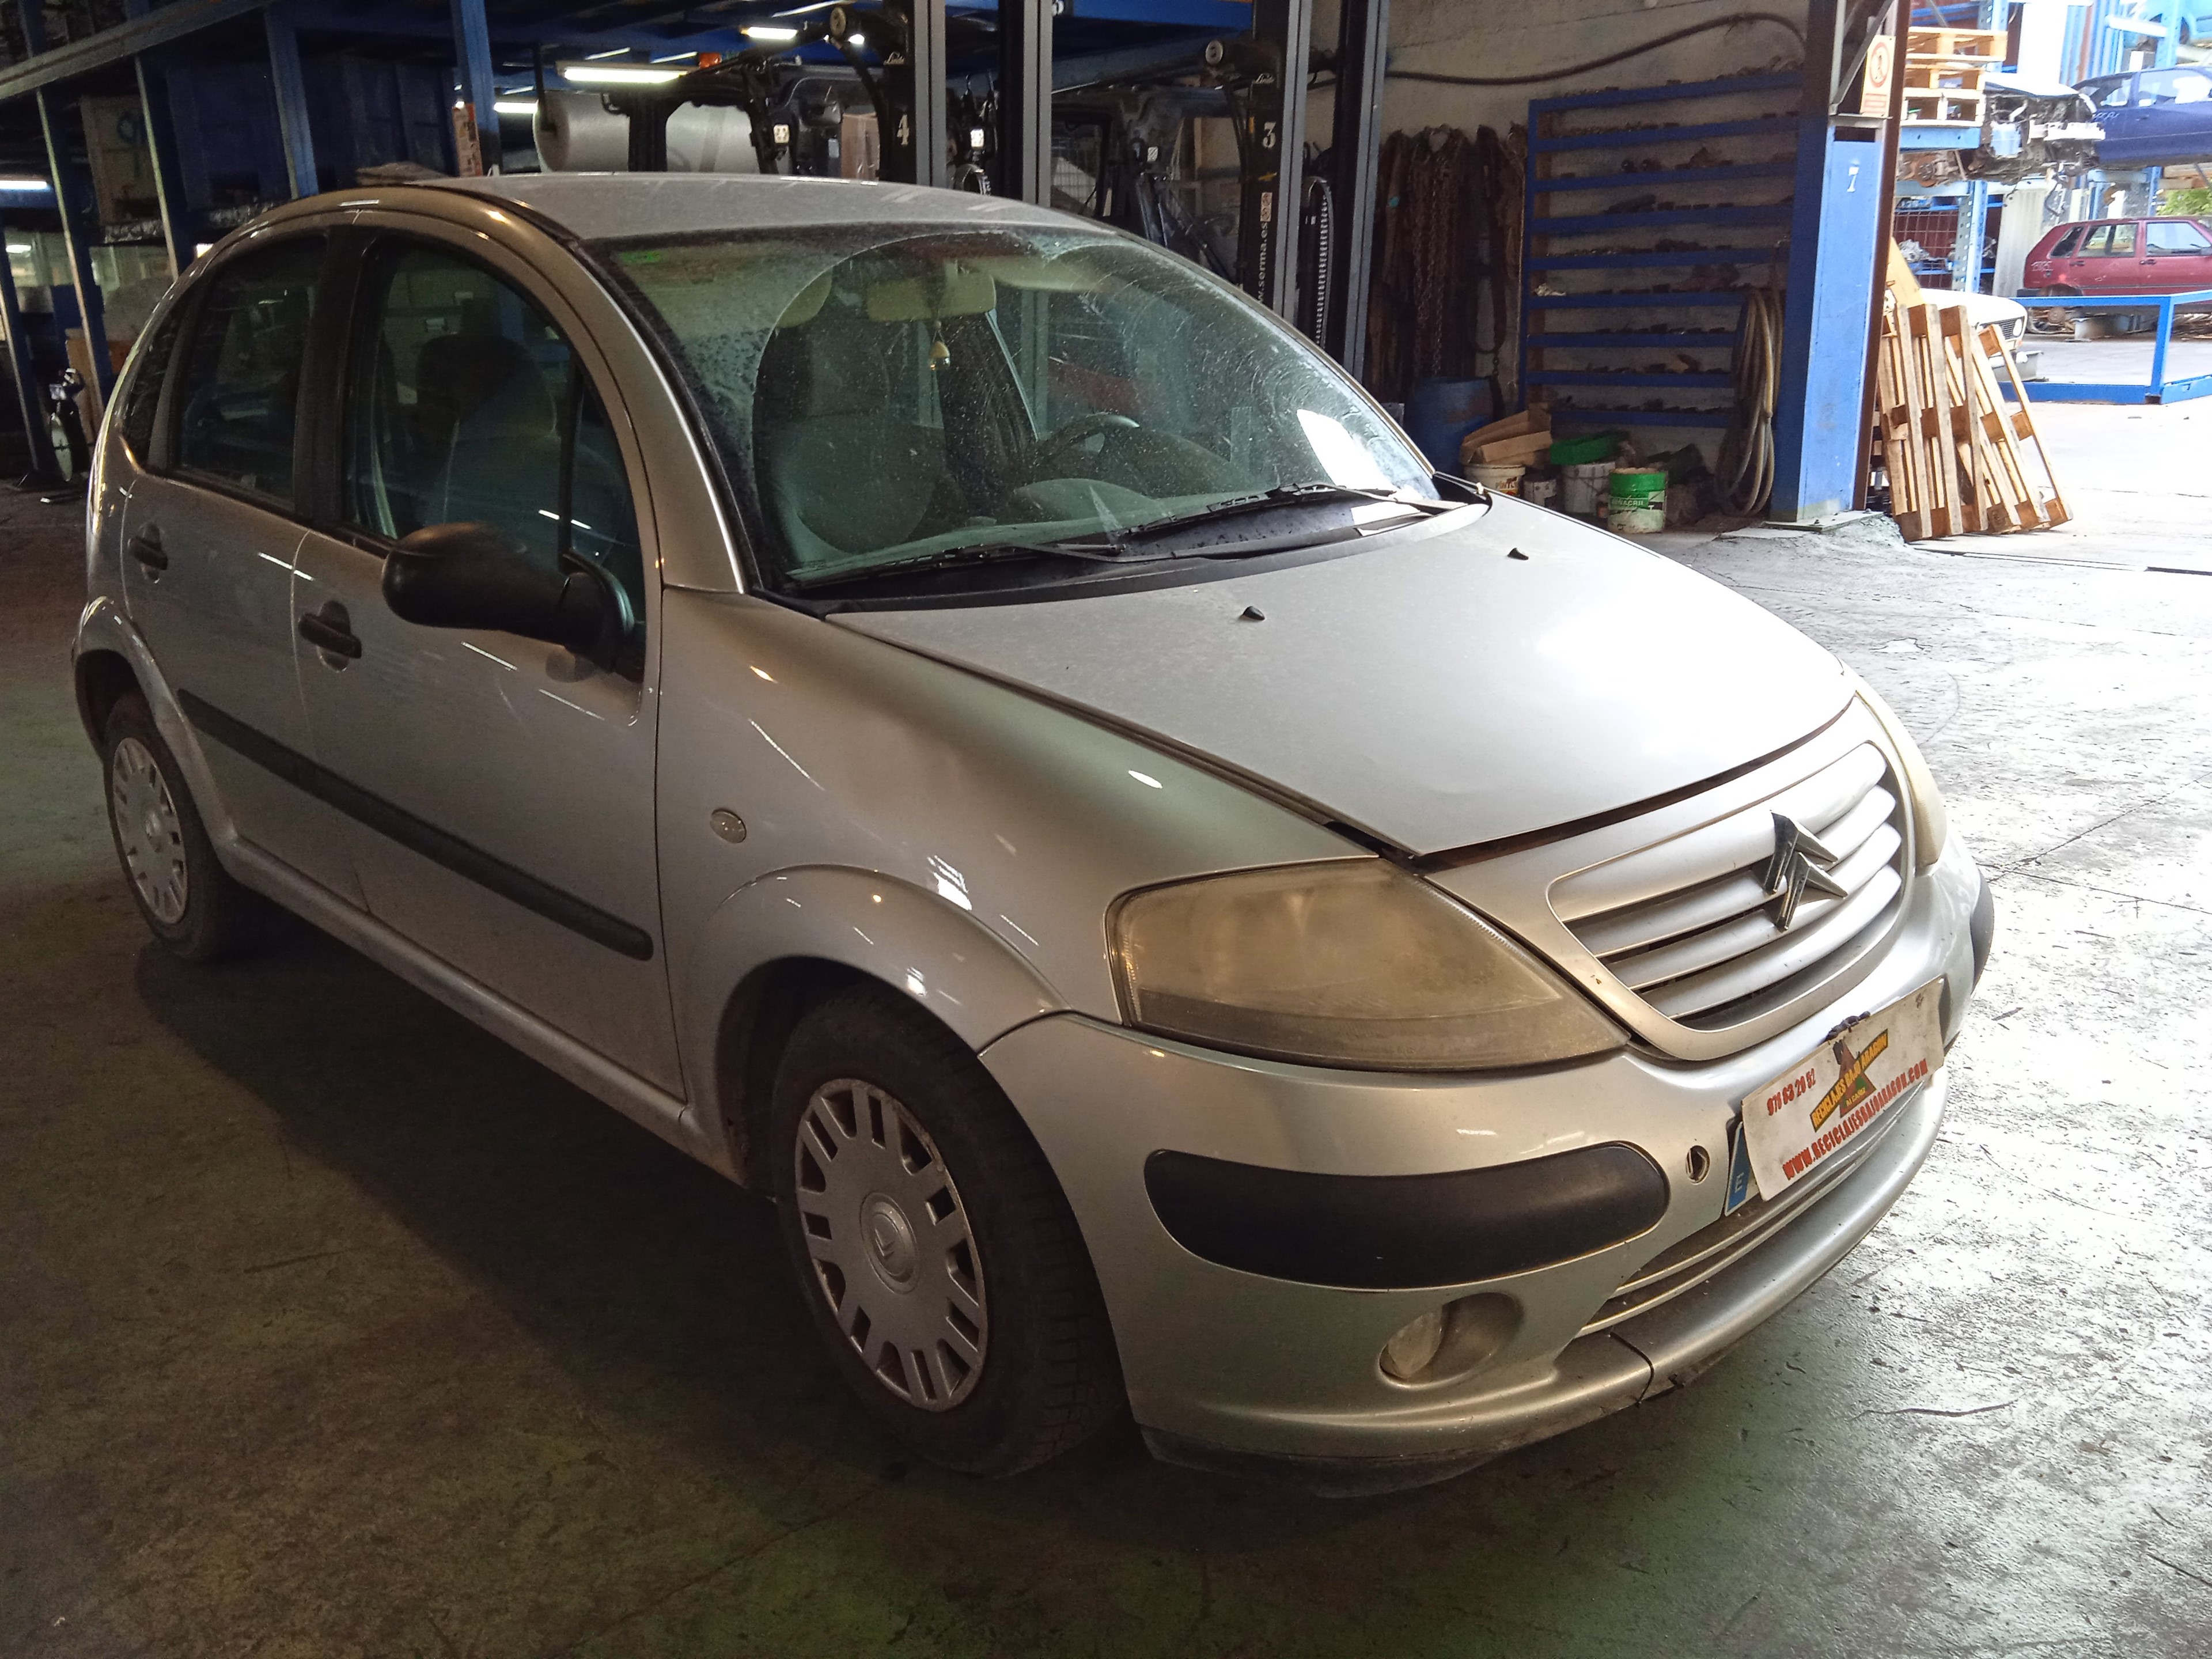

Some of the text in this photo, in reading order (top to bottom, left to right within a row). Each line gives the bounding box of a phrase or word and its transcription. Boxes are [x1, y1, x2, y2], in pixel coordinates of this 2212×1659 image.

[897, 115, 910, 145] 4
[1262, 122, 1276, 148] 3
[1795, 1076, 1806, 1097] 20
[1806, 1068, 1816, 1088] 52
[1811, 1078, 1846, 1126] RECICLAJES
[1844, 1060, 1861, 1087] BAJO
[1782, 1058, 1928, 1180] WWW.RECICLAJESBAJOARAGON.COM
[1734, 1172, 1744, 1193] E
